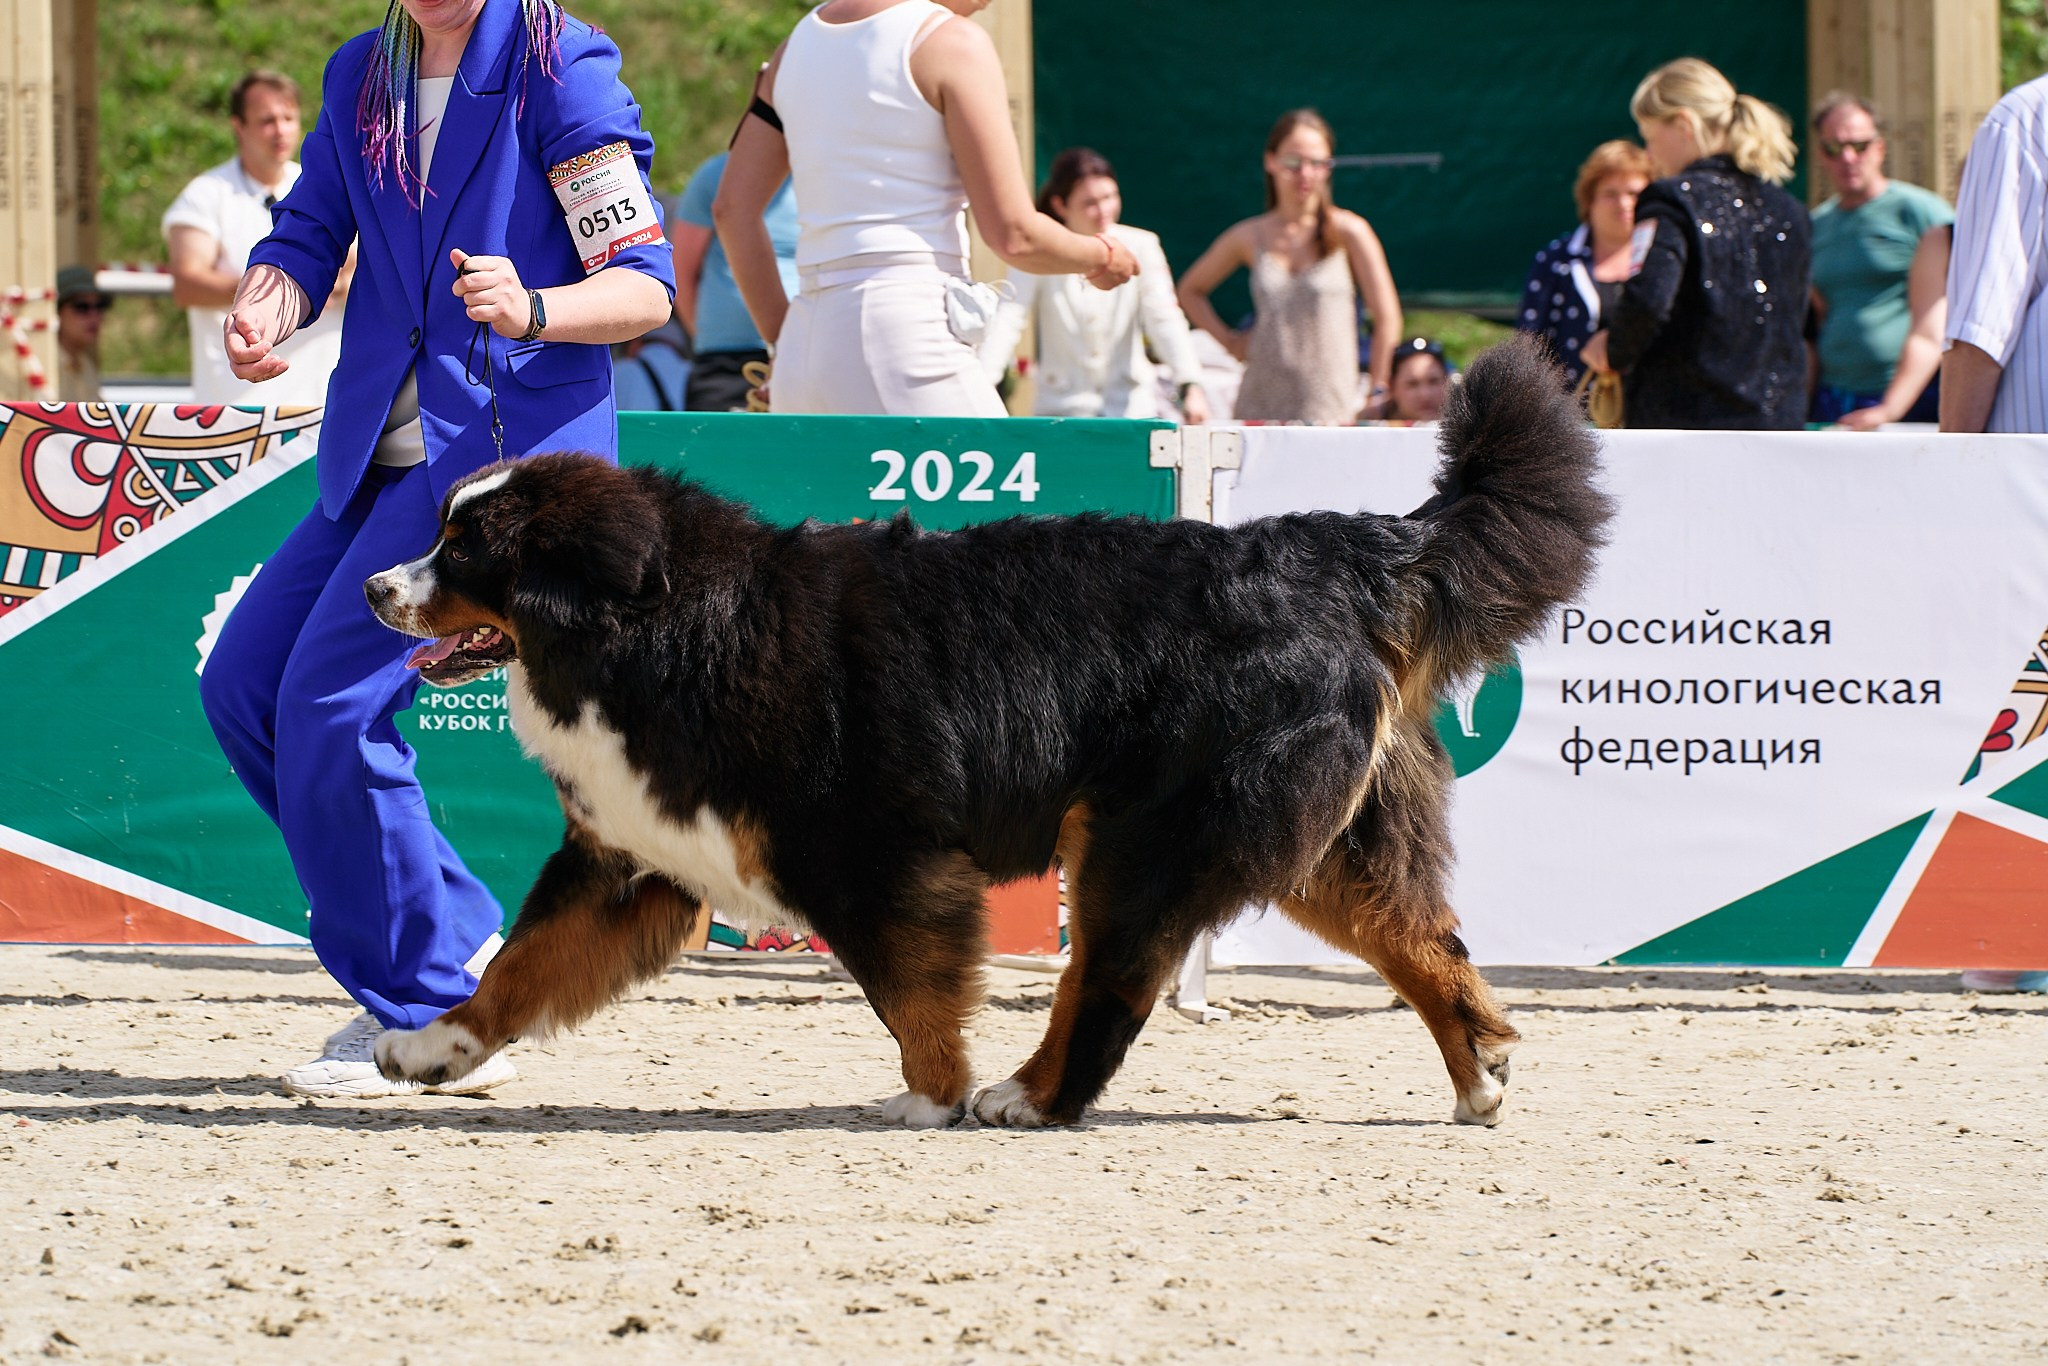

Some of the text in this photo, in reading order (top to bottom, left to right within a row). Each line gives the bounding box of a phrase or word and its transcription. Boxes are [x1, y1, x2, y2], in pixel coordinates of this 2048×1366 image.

[581, 169, 611, 187] РОССИЯ
[578, 198, 637, 239] 0513
[613, 230, 653, 253] 9.06.2024
[869, 449, 1041, 502] 2024
[1561, 607, 1832, 645] Российская
[420, 693, 508, 709] «РОССИ
[1561, 678, 1942, 705] кинологическая
[419, 714, 491, 731] КУБОК
[1560, 726, 1822, 776] федерация
